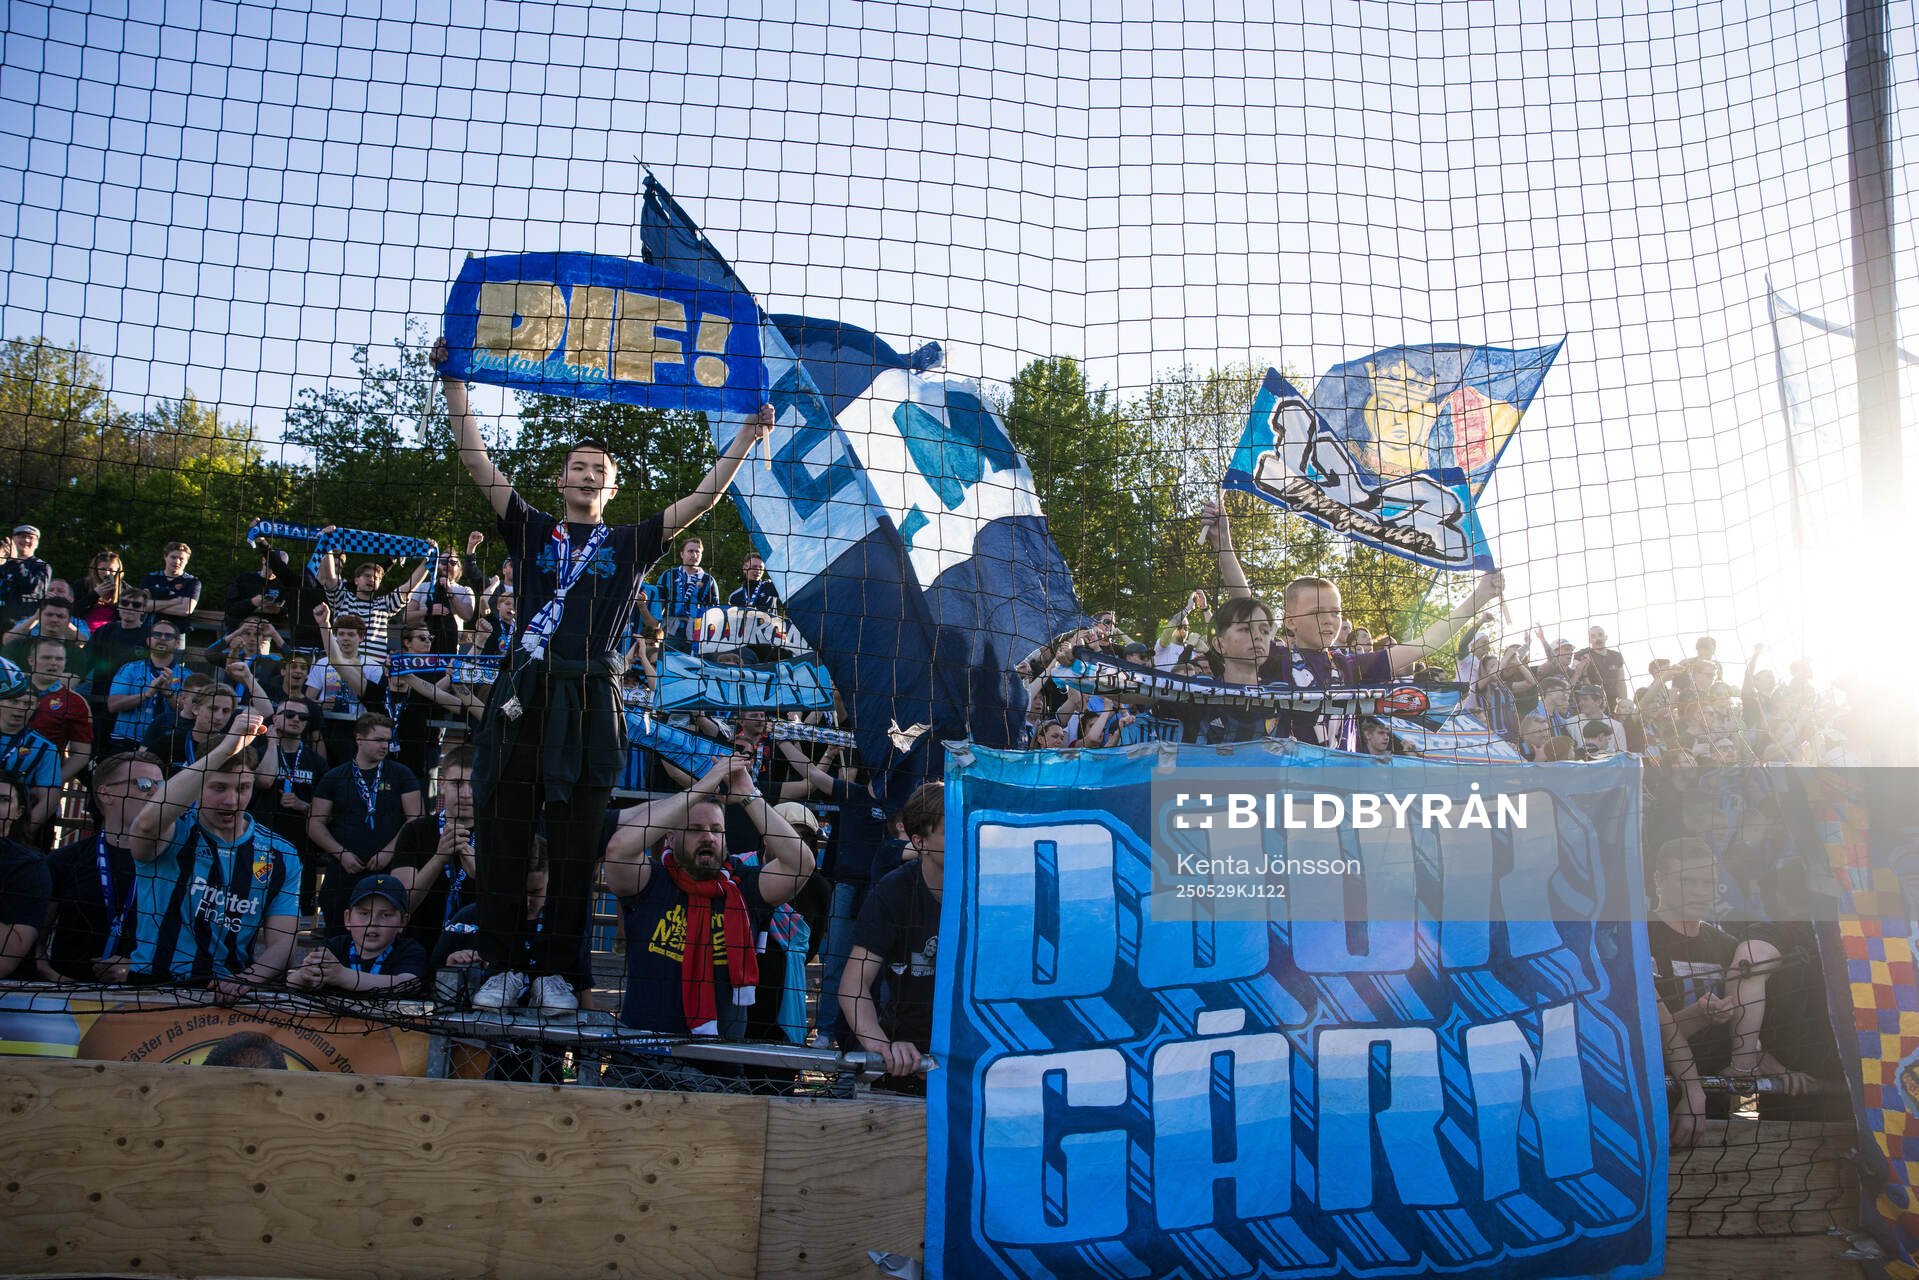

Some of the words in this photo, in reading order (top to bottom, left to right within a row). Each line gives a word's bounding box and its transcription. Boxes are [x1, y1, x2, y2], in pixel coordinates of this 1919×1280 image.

[474, 280, 732, 388] DIF!
[190, 876, 260, 915] Prioitet
[165, 1021, 184, 1043] på
